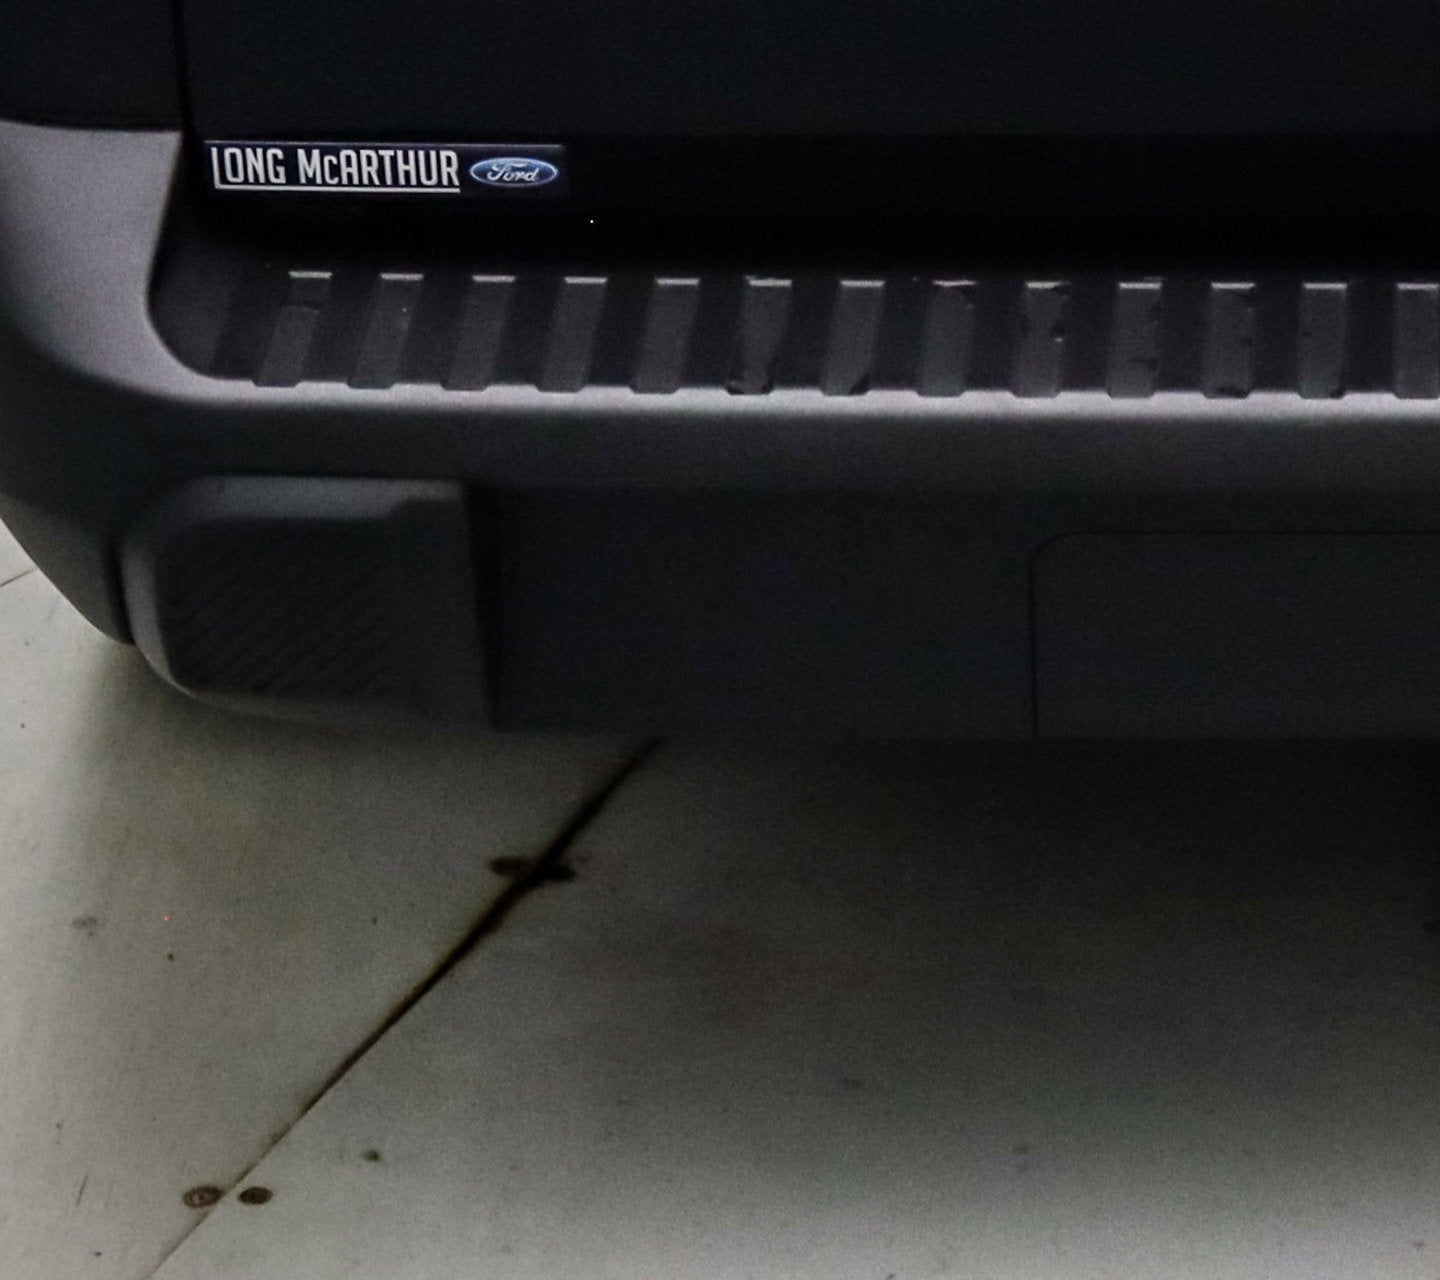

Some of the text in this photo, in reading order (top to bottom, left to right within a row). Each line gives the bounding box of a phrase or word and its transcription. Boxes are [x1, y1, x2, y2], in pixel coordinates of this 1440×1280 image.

[211, 146, 540, 189] LONG McARTHUR Ford
